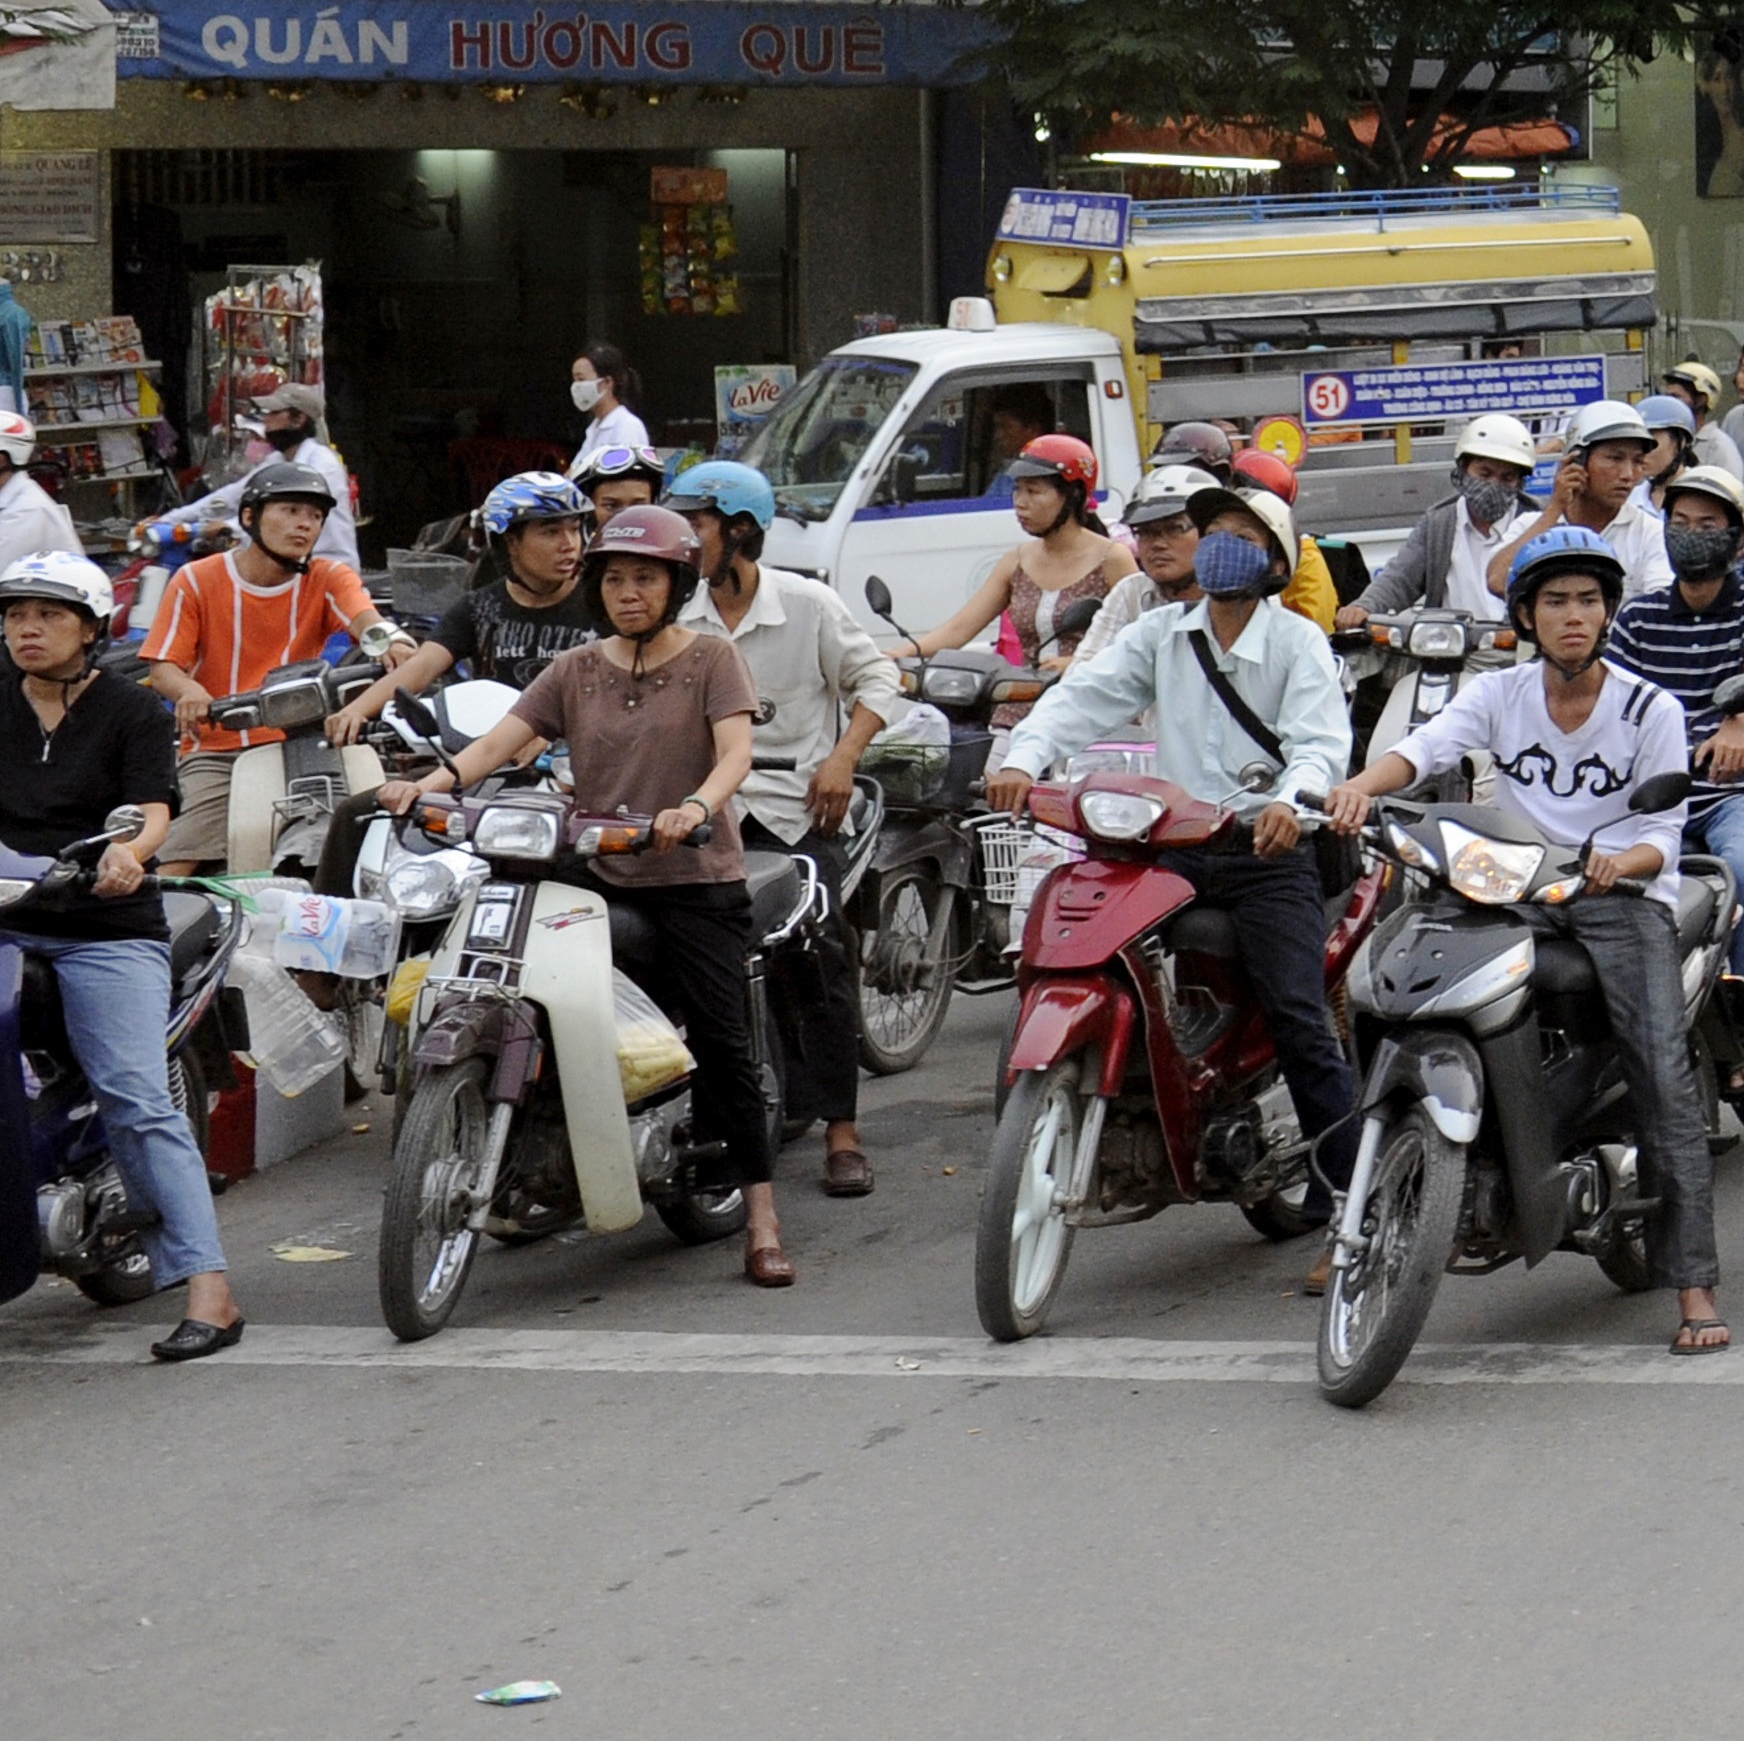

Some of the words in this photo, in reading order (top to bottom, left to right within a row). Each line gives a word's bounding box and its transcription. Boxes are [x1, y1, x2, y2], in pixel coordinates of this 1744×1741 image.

[202, 7, 408, 71] QUÁN
[450, 11, 693, 71] HƯƠNG
[742, 16, 885, 74] QUÊ
[1316, 385, 1339, 410] 51
